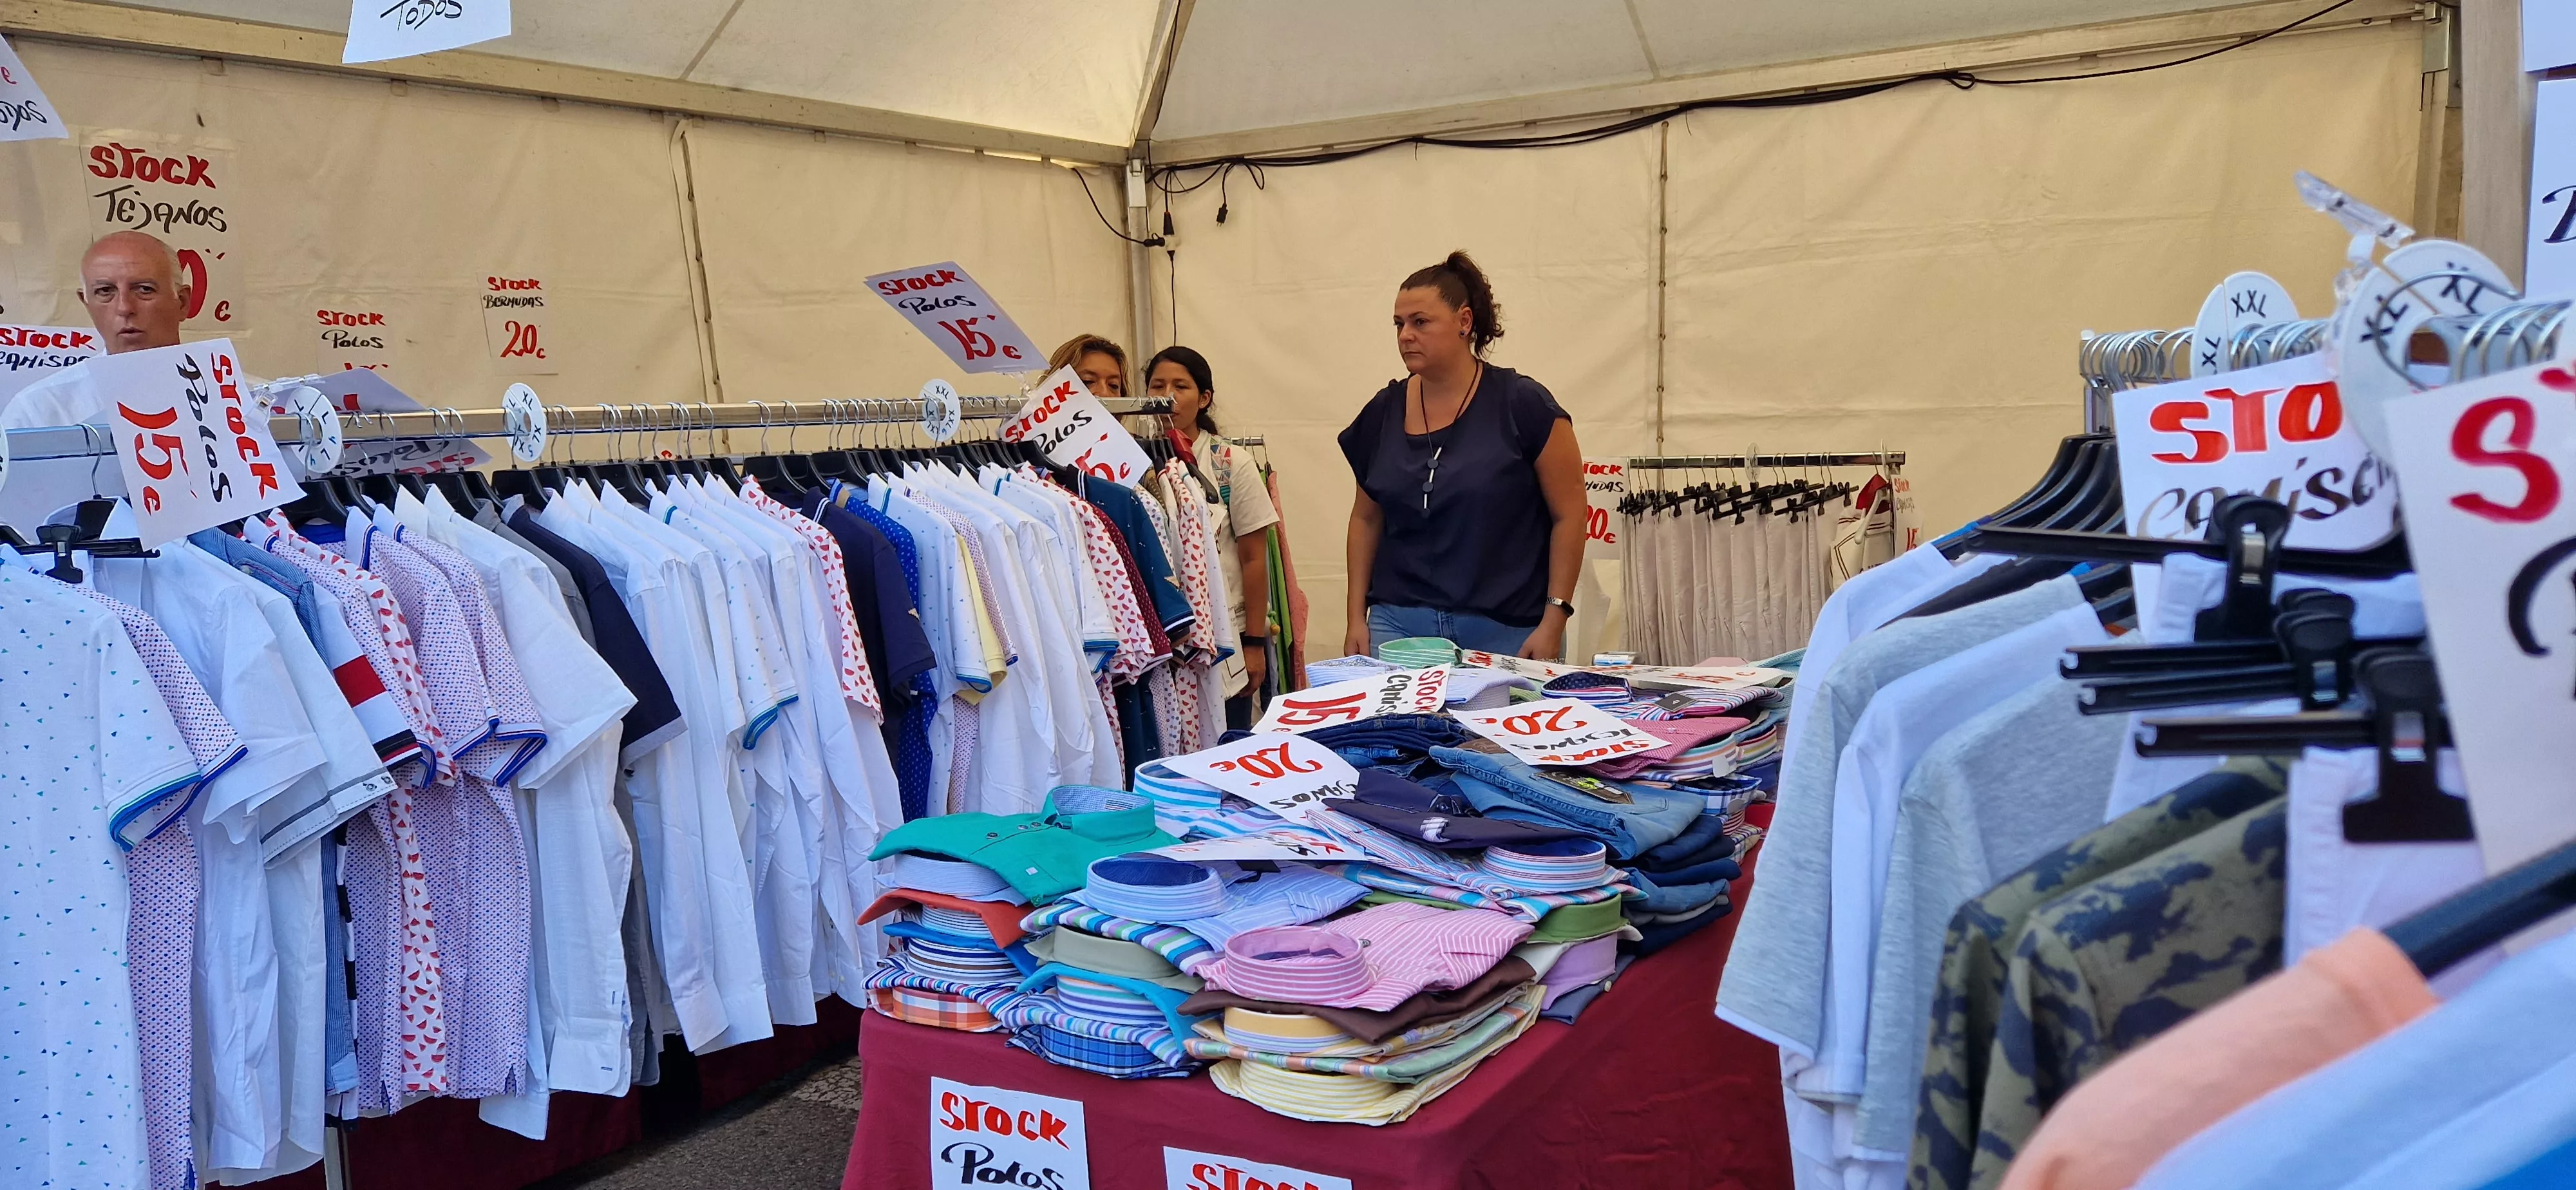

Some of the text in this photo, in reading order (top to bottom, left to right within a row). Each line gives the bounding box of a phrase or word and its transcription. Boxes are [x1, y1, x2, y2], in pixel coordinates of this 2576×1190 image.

[87, 142, 216, 189] STOCK
[93, 184, 227, 234] TEJANOS
[488, 276, 543, 291] STOCK
[878, 269, 965, 296] STOCK
[482, 294, 545, 309] BERMUDAS
[2230, 289, 2267, 318] XXL
[317, 309, 386, 326] STOCK
[0, 326, 97, 351] STOCK
[522, 390, 533, 411] XL
[935, 385, 949, 400] XXL
[945, 410, 955, 430] XXL
[1005, 380, 1079, 443] STOCK
[2149, 380, 2344, 464] STO
[210, 352, 279, 501] STOCK
[531, 424, 542, 444] XL
[1583, 460, 1624, 477] TOCK
[1535, 739, 1650, 763] STOCK
[939, 1091, 1070, 1151] STOCK
